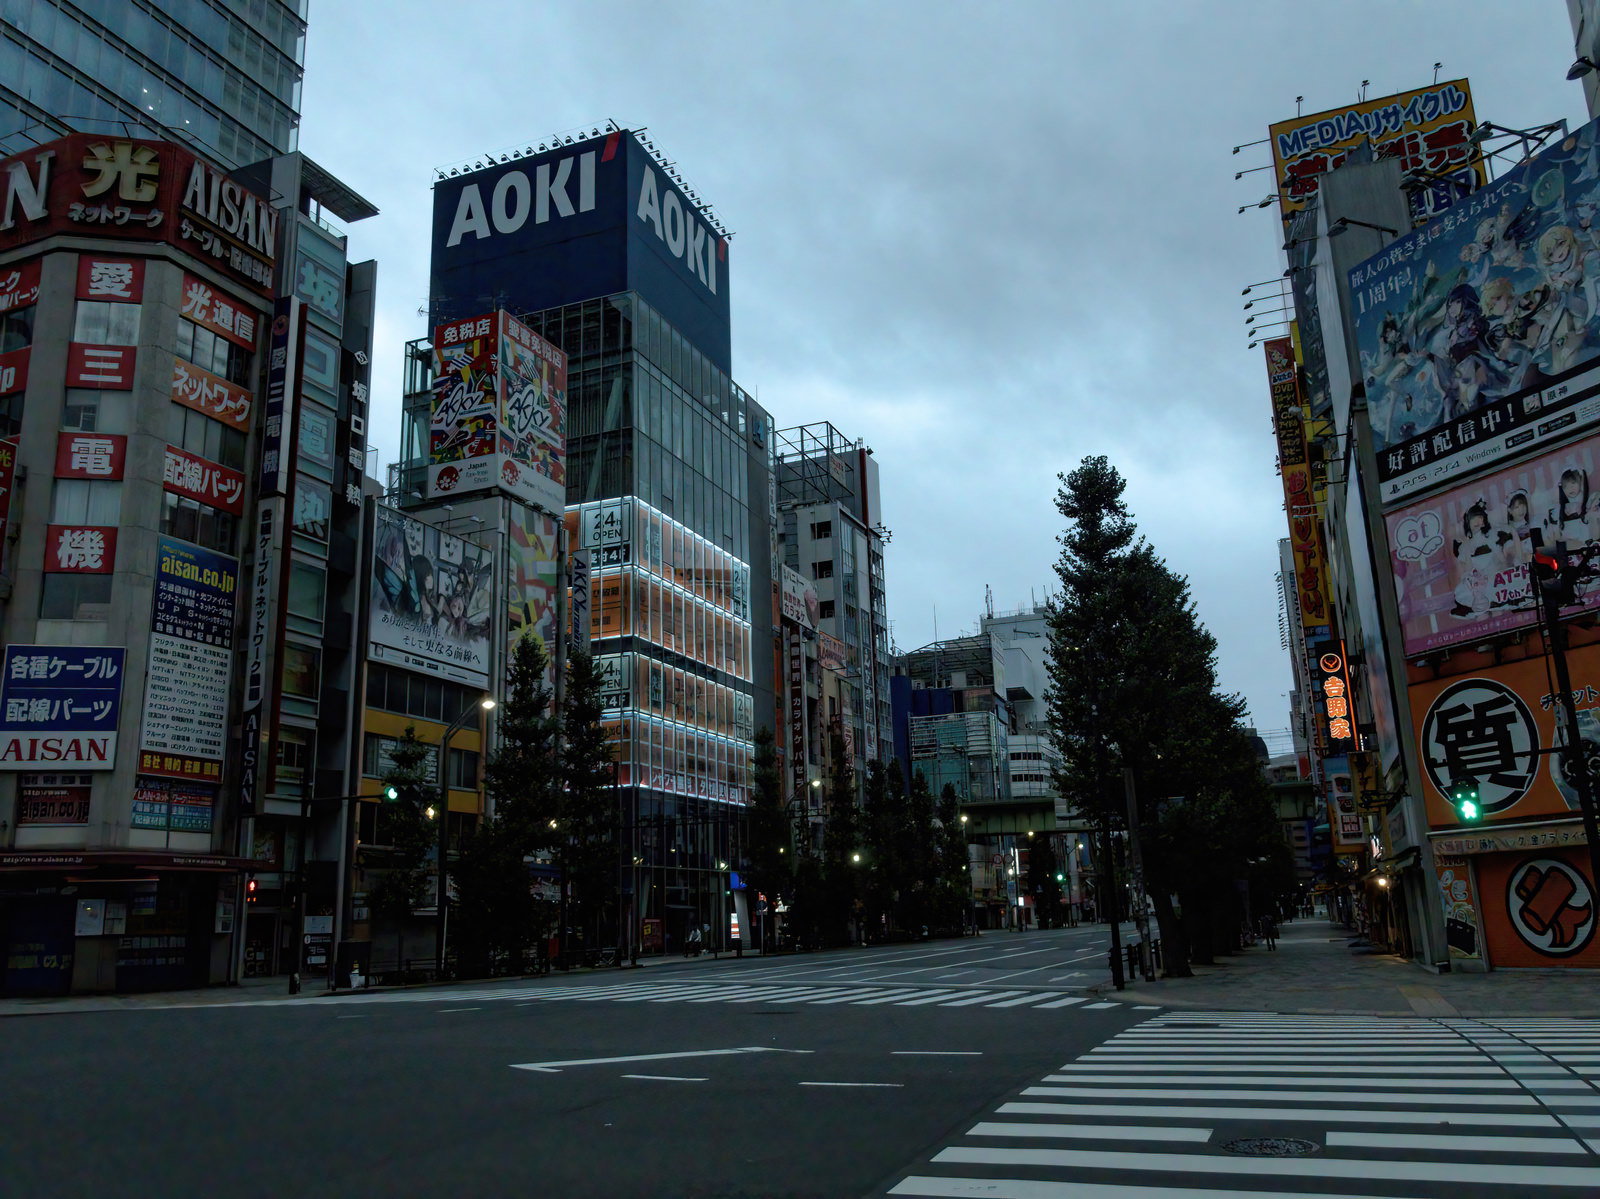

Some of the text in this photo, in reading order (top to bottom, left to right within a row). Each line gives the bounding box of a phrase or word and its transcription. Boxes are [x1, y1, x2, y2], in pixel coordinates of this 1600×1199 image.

[0, 149, 56, 231] N
[80, 140, 161, 202] 光
[66, 201, 165, 228] ネットワーク
[182, 157, 279, 260] AISAN
[446, 150, 596, 248] AOKI
[637, 163, 717, 296] AOKI
[88, 261, 134, 298] 愛
[181, 281, 255, 344] 光通信
[443, 318, 491, 344] 免税店
[79, 349, 124, 384] 三
[172, 365, 250, 422] ネットワーク
[70, 437, 115, 475] 電
[164, 452, 243, 505] 配線パーツ
[57, 528, 105, 569] 機
[161, 555, 235, 593] aisan.co.jp
[11, 655, 118, 681] 各種ケーブル
[5, 697, 113, 723] 配線パーツ
[1540, 684, 1600, 712] チット
[0, 738, 109, 762] AISAN
[240, 713, 258, 805] AISAN
[1434, 691, 1532, 798] 質
